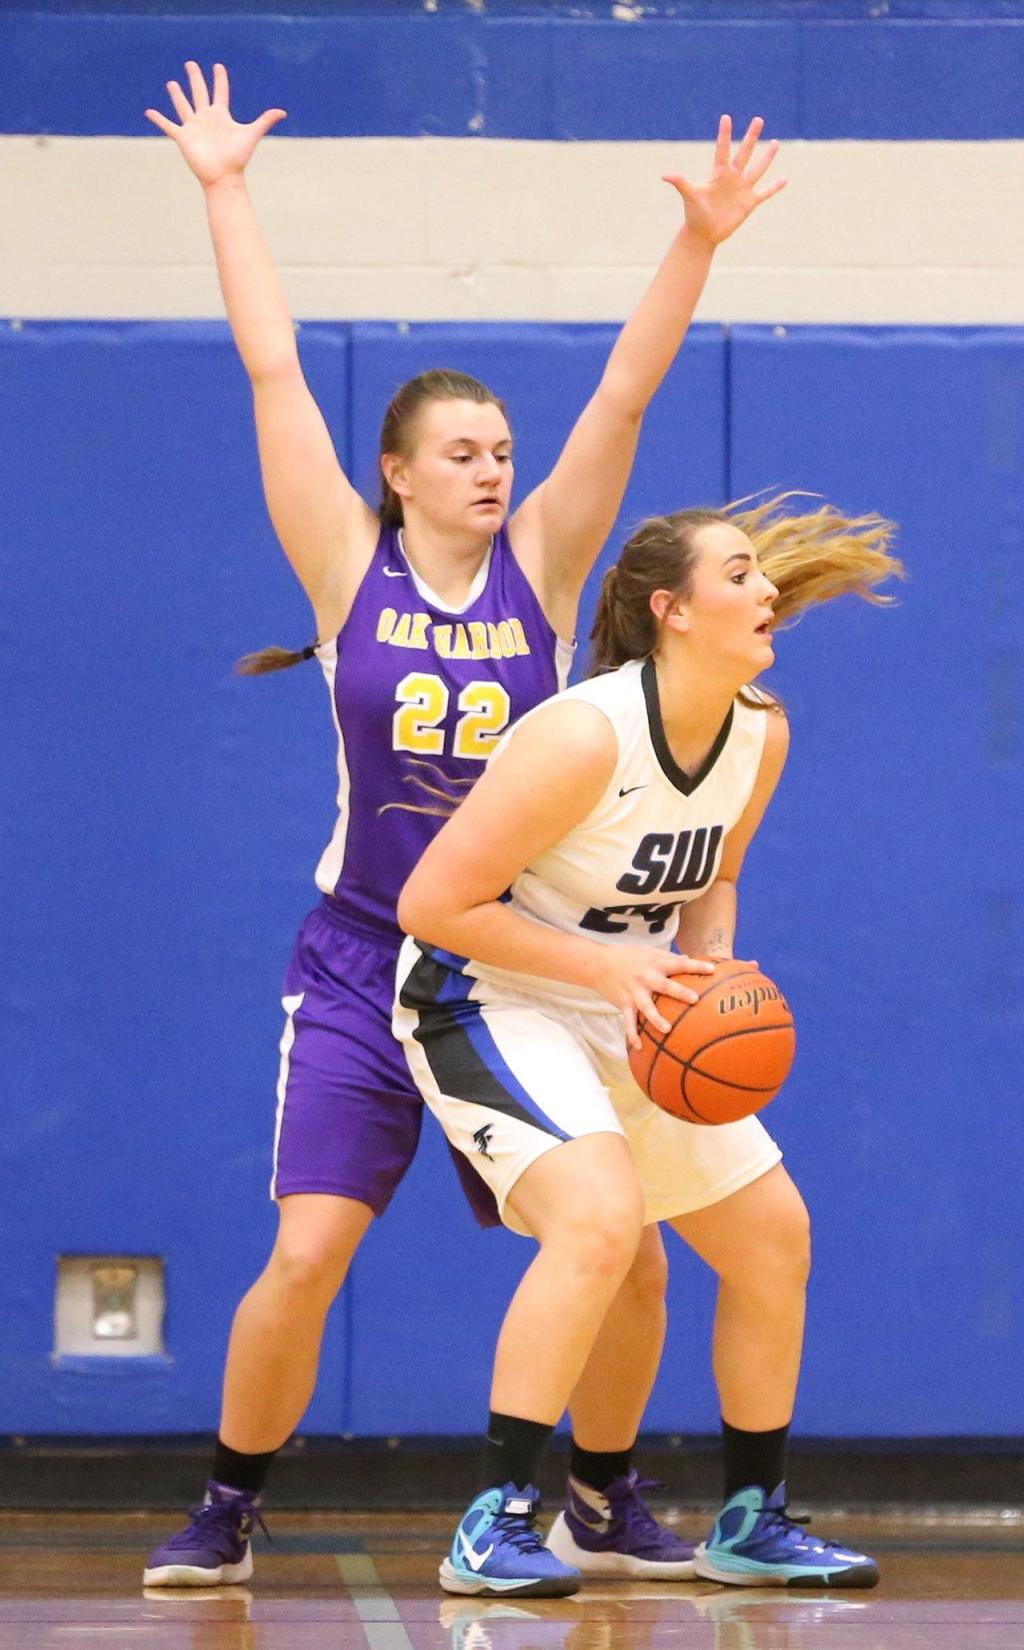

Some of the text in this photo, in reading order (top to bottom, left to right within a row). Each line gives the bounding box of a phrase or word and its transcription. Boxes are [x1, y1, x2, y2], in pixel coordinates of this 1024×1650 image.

[376, 607, 432, 650] OAK
[392, 671, 511, 760] 22
[616, 825, 723, 895] SW
[719, 987, 789, 1015] aden
